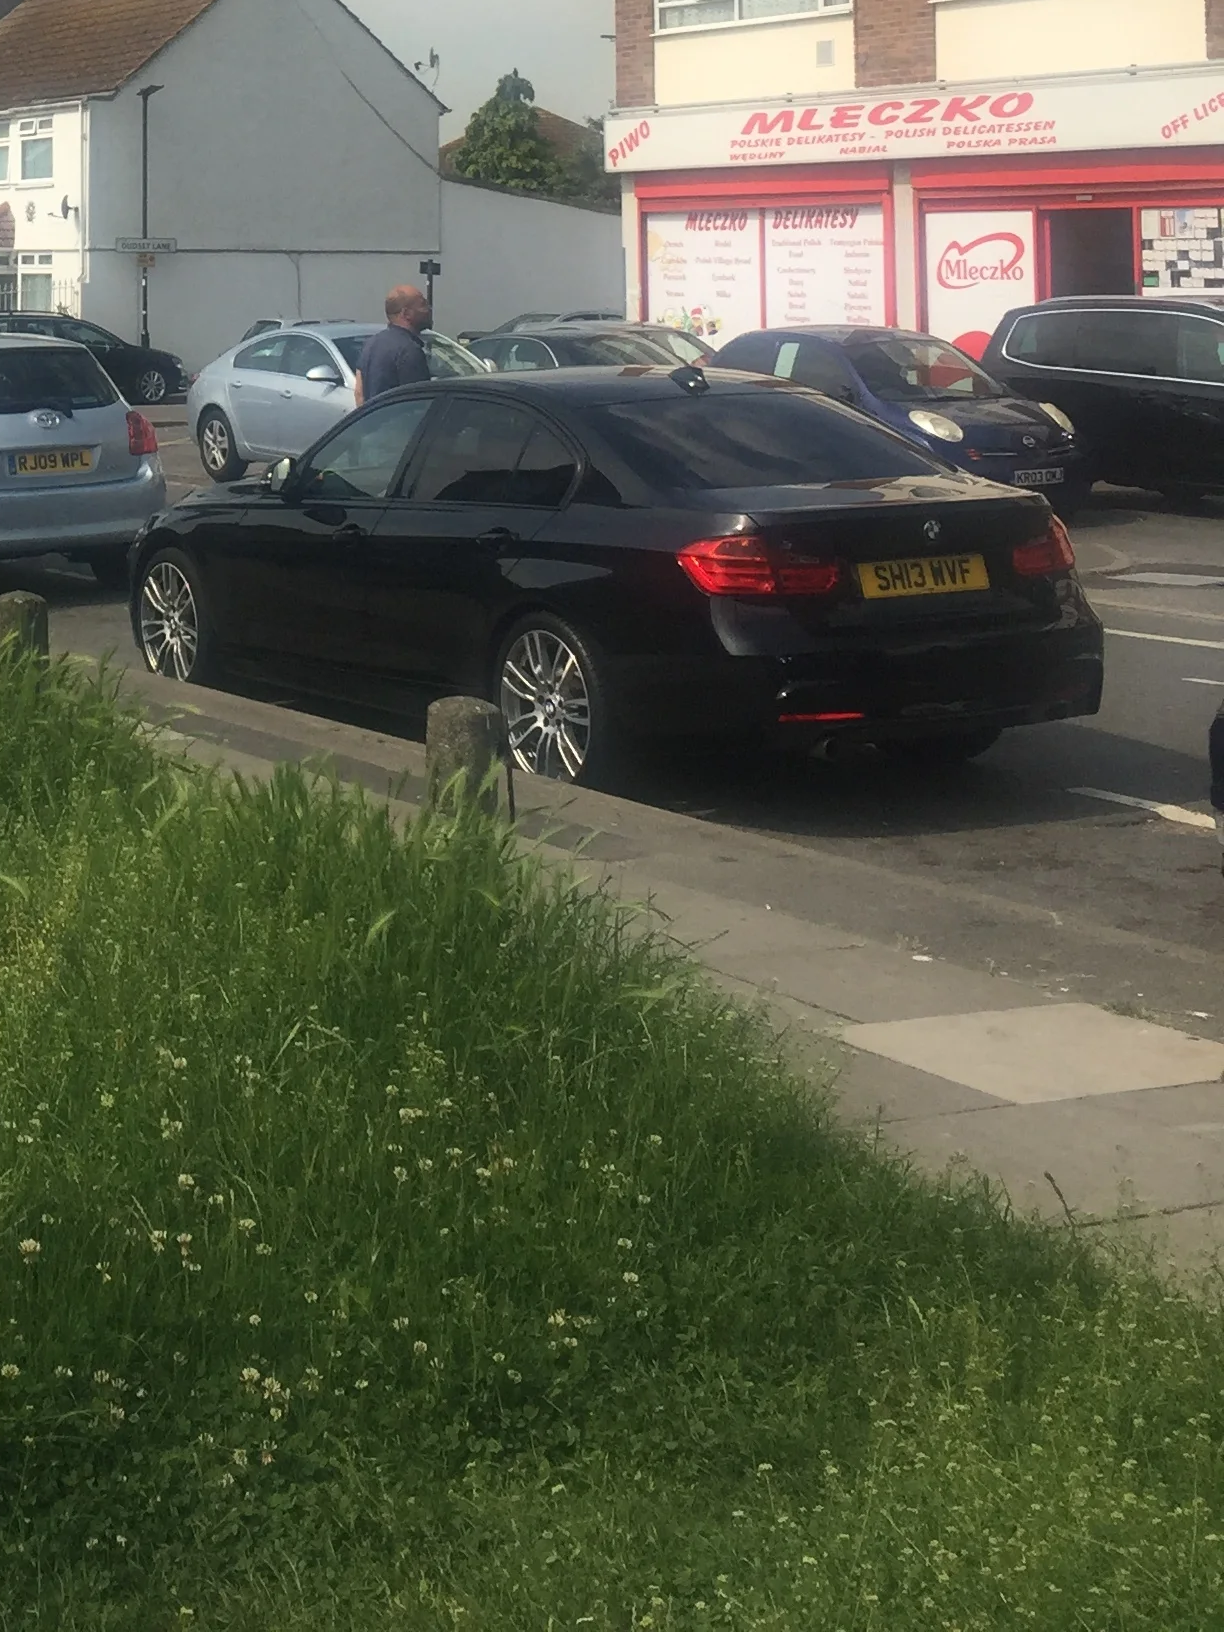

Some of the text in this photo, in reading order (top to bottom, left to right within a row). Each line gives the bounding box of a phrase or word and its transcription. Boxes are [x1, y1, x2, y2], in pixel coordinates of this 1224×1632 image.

[740, 91, 1034, 135] MLECZKO
[729, 138, 782, 149] POLSKIE
[787, 131, 866, 147] DELIKATESY
[884, 127, 937, 140] POLISH
[942, 120, 1056, 136] DELICATESSEN
[1161, 114, 1189, 139] OFF
[608, 120, 651, 167] PIWO
[946, 136, 1057, 149] POLSKA PRASA
[685, 211, 748, 232] MLECZKO
[772, 207, 860, 229] DELIKATESY
[944, 258, 1024, 280] Mleczko
[18, 451, 90, 472] RJ09 WPL
[1016, 471, 1043, 484] KR03
[874, 558, 970, 591] SH13 WVF
